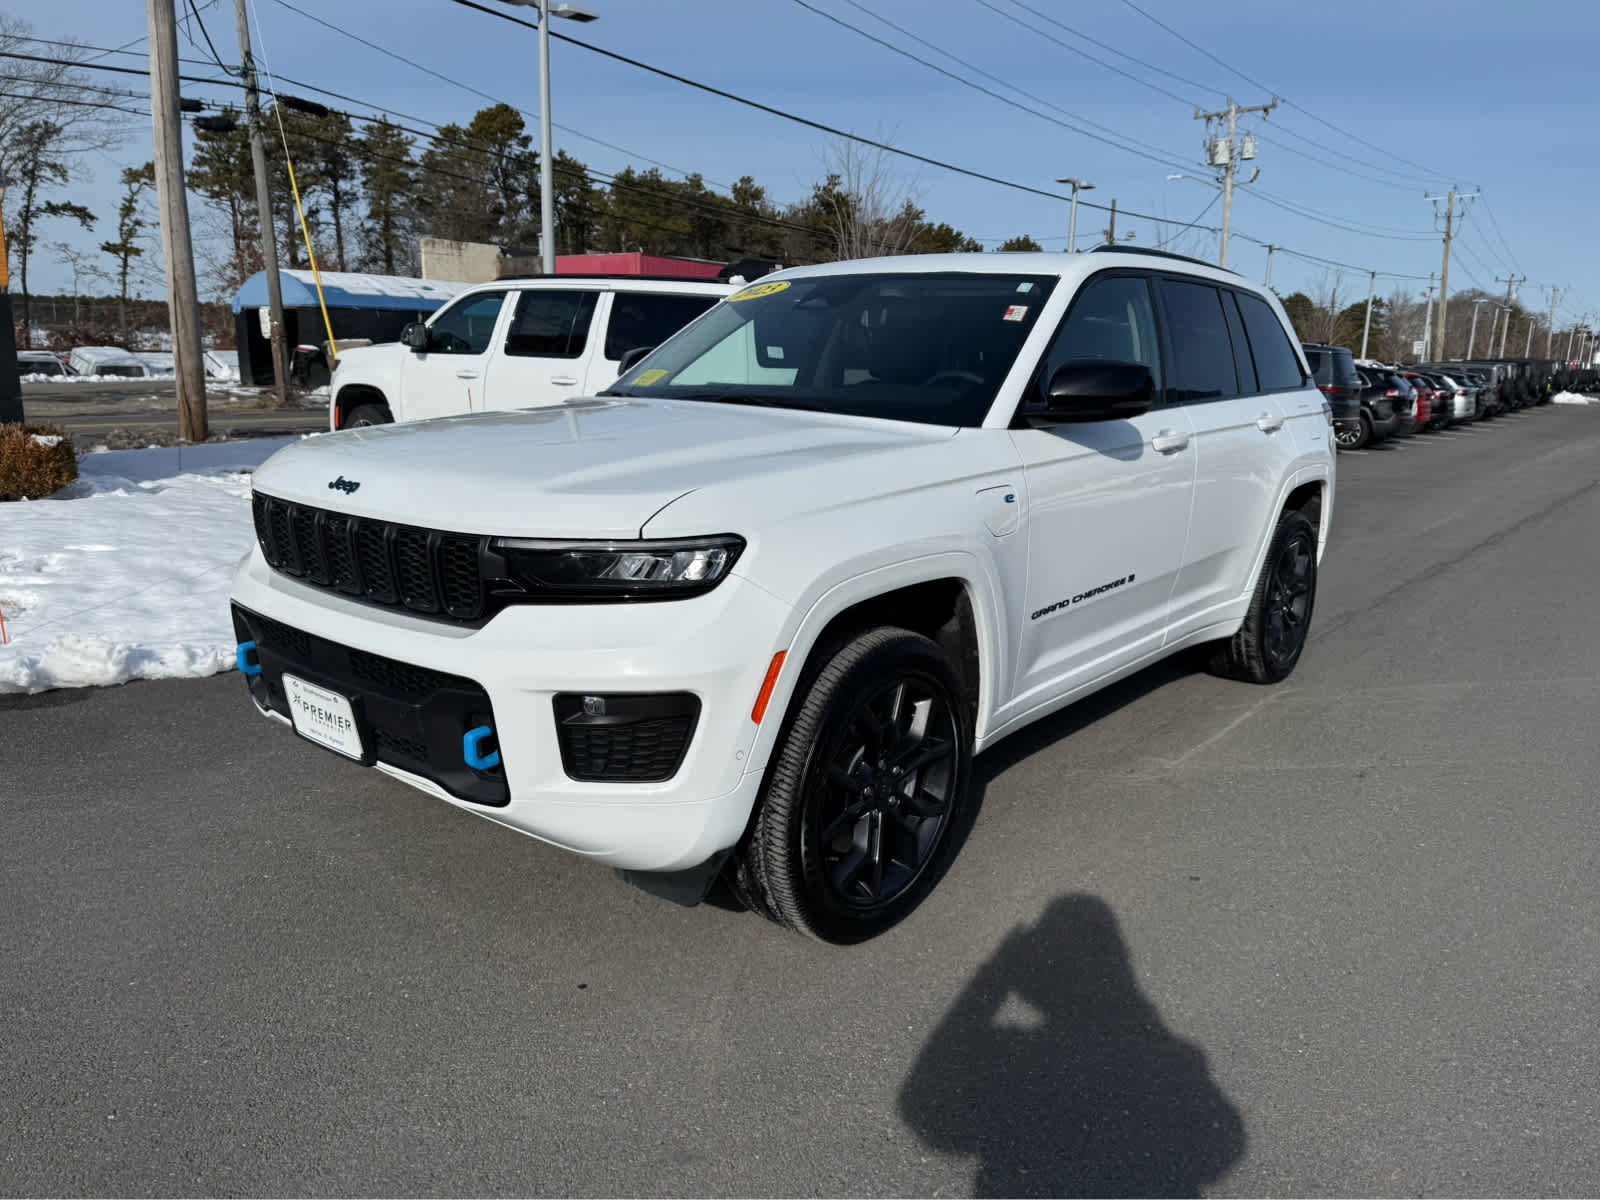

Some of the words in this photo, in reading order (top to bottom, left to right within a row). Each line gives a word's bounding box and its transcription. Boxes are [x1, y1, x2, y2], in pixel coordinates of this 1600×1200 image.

[327, 475, 361, 496] Jeep
[1031, 599, 1070, 620] GRAND
[1071, 577, 1127, 603] CHEROKEE
[303, 701, 352, 731] PREMIER
